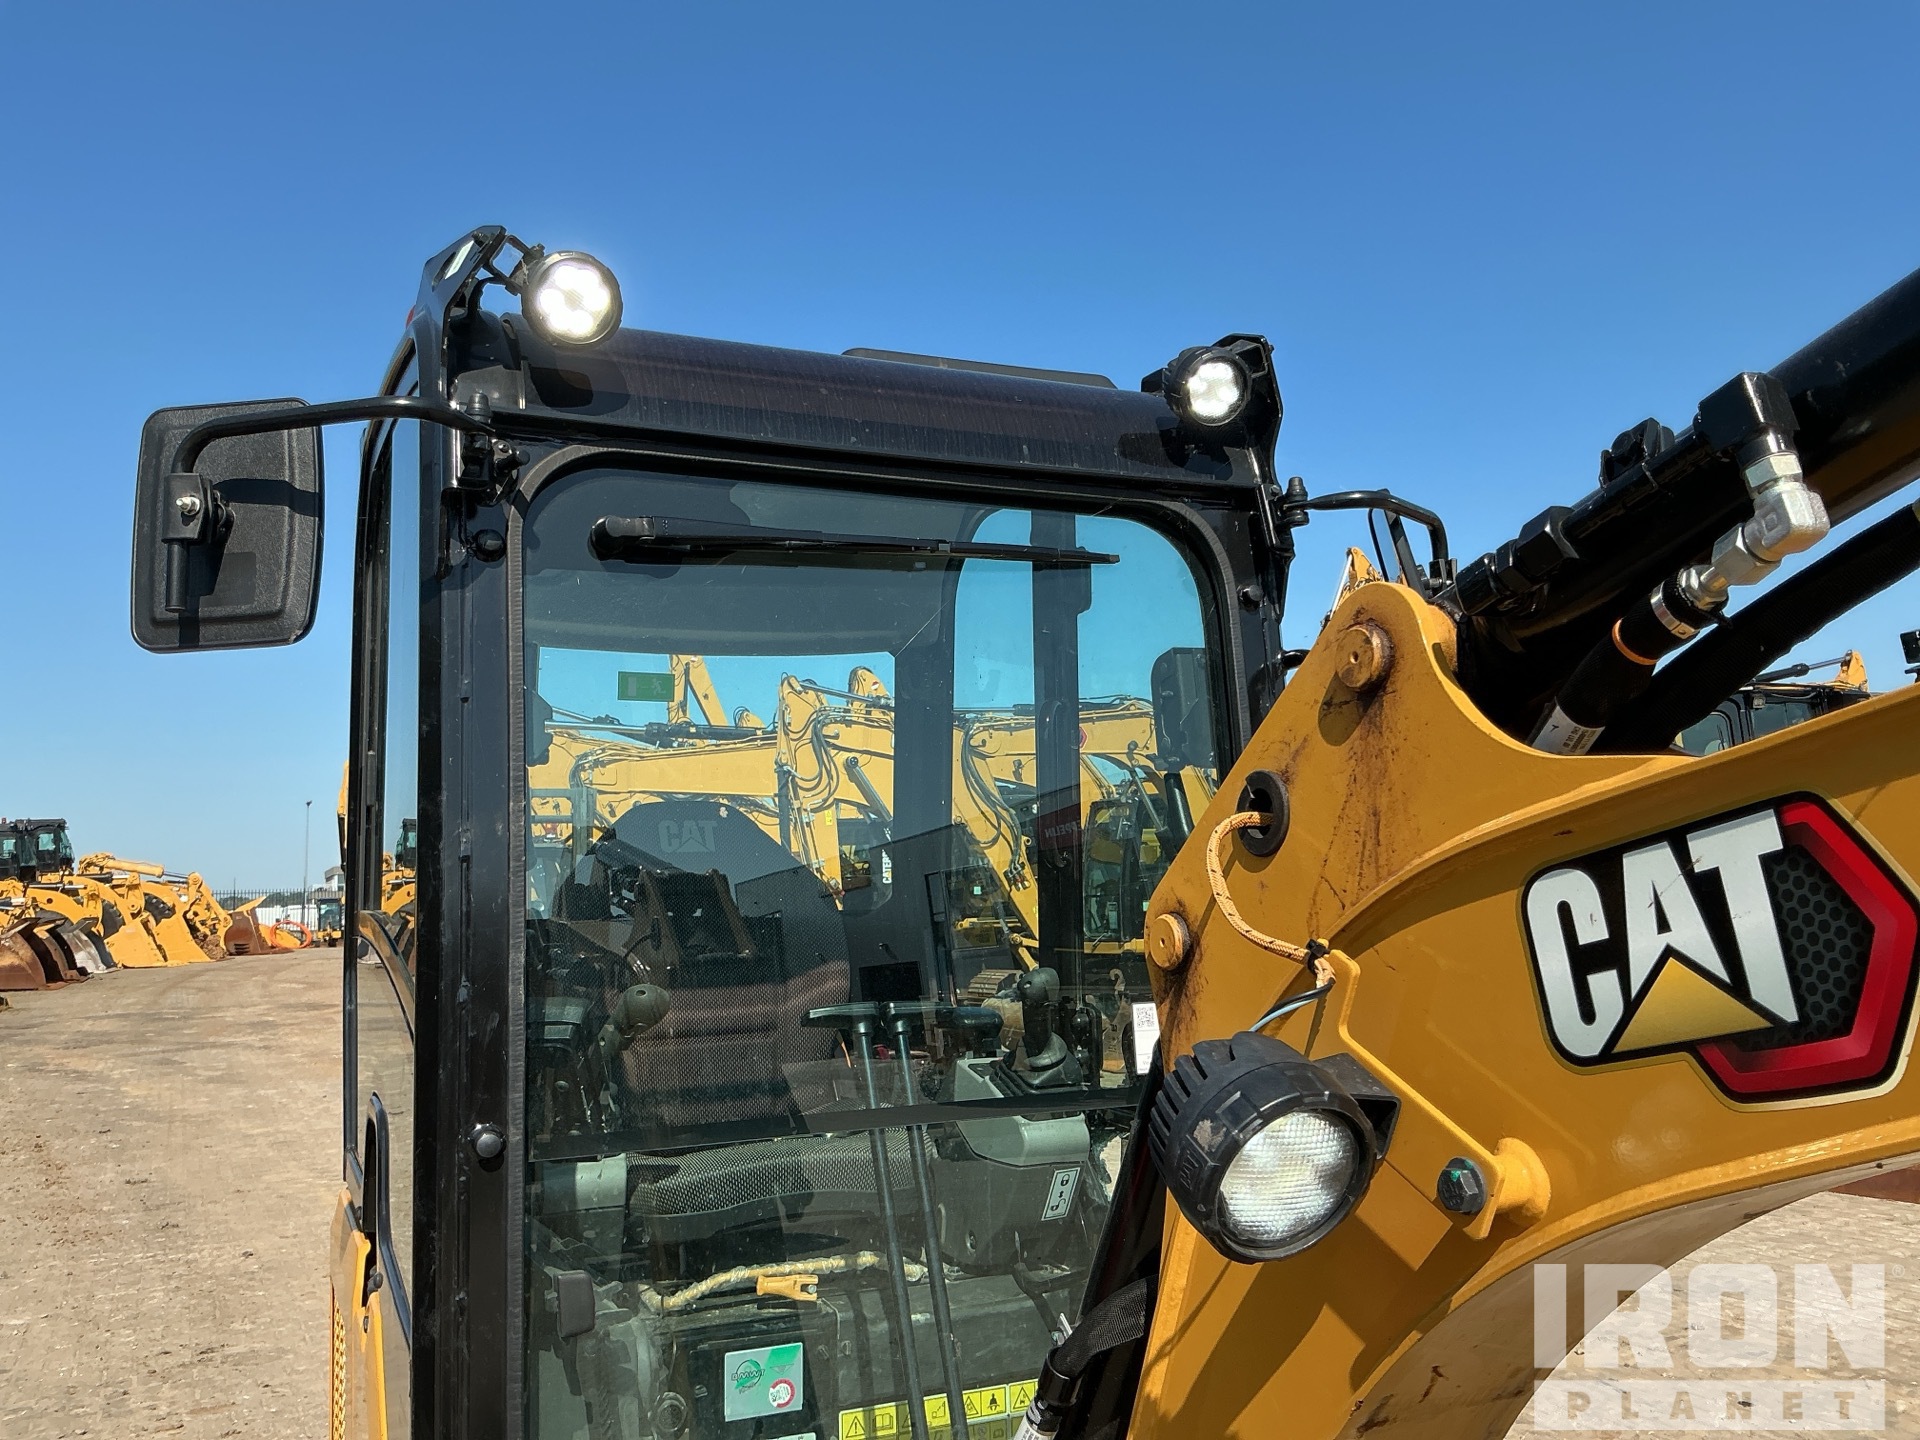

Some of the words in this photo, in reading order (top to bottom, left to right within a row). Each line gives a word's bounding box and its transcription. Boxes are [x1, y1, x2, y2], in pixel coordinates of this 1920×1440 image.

[658, 820, 718, 853] CAT
[882, 849, 892, 884] CATERP
[1527, 809, 1799, 1056] CAT
